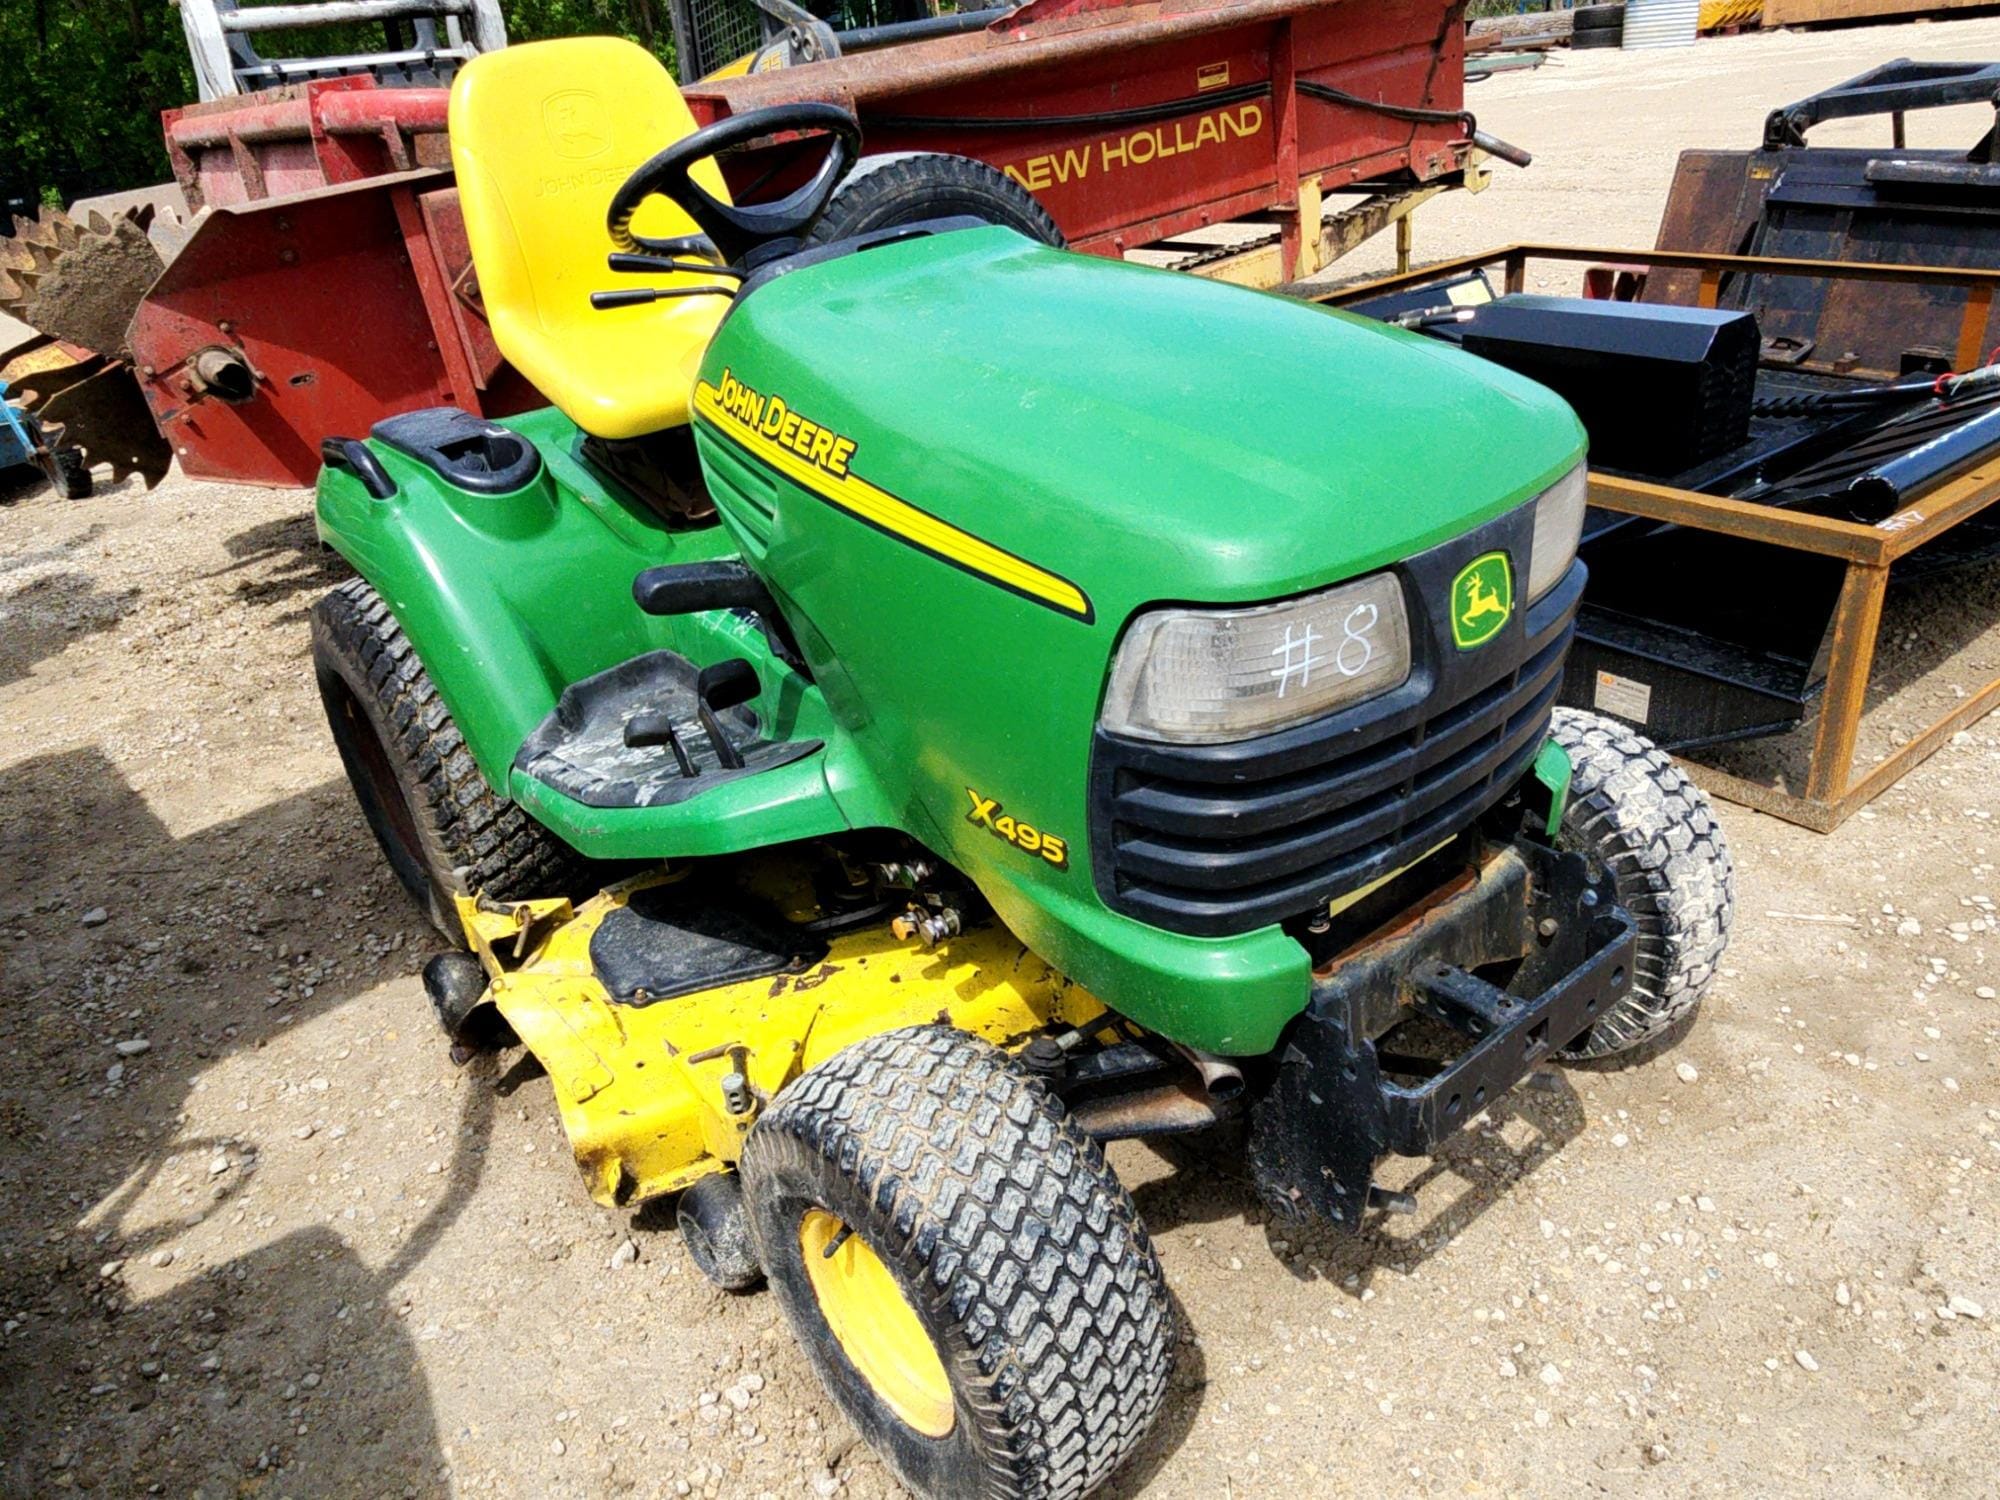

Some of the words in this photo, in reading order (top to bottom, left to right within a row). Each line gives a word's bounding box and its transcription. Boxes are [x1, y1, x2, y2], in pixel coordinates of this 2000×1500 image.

[1101, 104, 1263, 173] HOLLAND
[535, 173, 585, 198] JOHN
[713, 367, 766, 430] JOHN
[762, 394, 858, 480] DEERE
[966, 787, 1068, 869] X495
